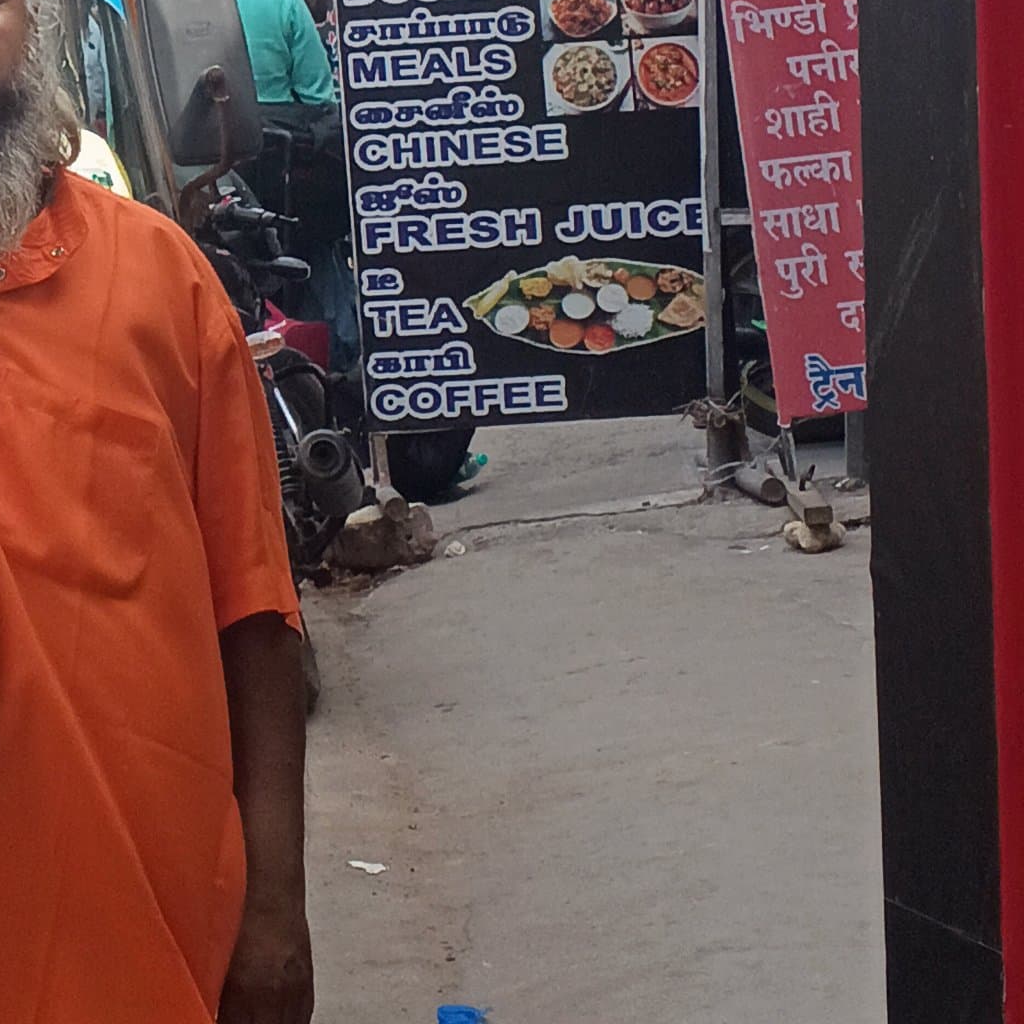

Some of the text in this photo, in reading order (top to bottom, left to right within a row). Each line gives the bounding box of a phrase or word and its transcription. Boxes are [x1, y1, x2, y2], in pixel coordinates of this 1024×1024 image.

[343, 6, 535, 47] சாப்பாடு
[348, 44, 517, 89] MEALS
[350, 85, 524, 129] சைனீஸ்
[765, 90, 841, 139] शाही
[354, 123, 569, 171] CHINESE
[355, 172, 467, 216] ஜூஸ்
[361, 197, 702, 254] FRESH JUICE
[760, 202, 840, 240] साधा
[361, 268, 404, 296] டீ
[775, 242, 828, 299] पुरी
[364, 298, 467, 337] TEA
[367, 341, 476, 378] காபி
[371, 375, 568, 421] COFFEE
